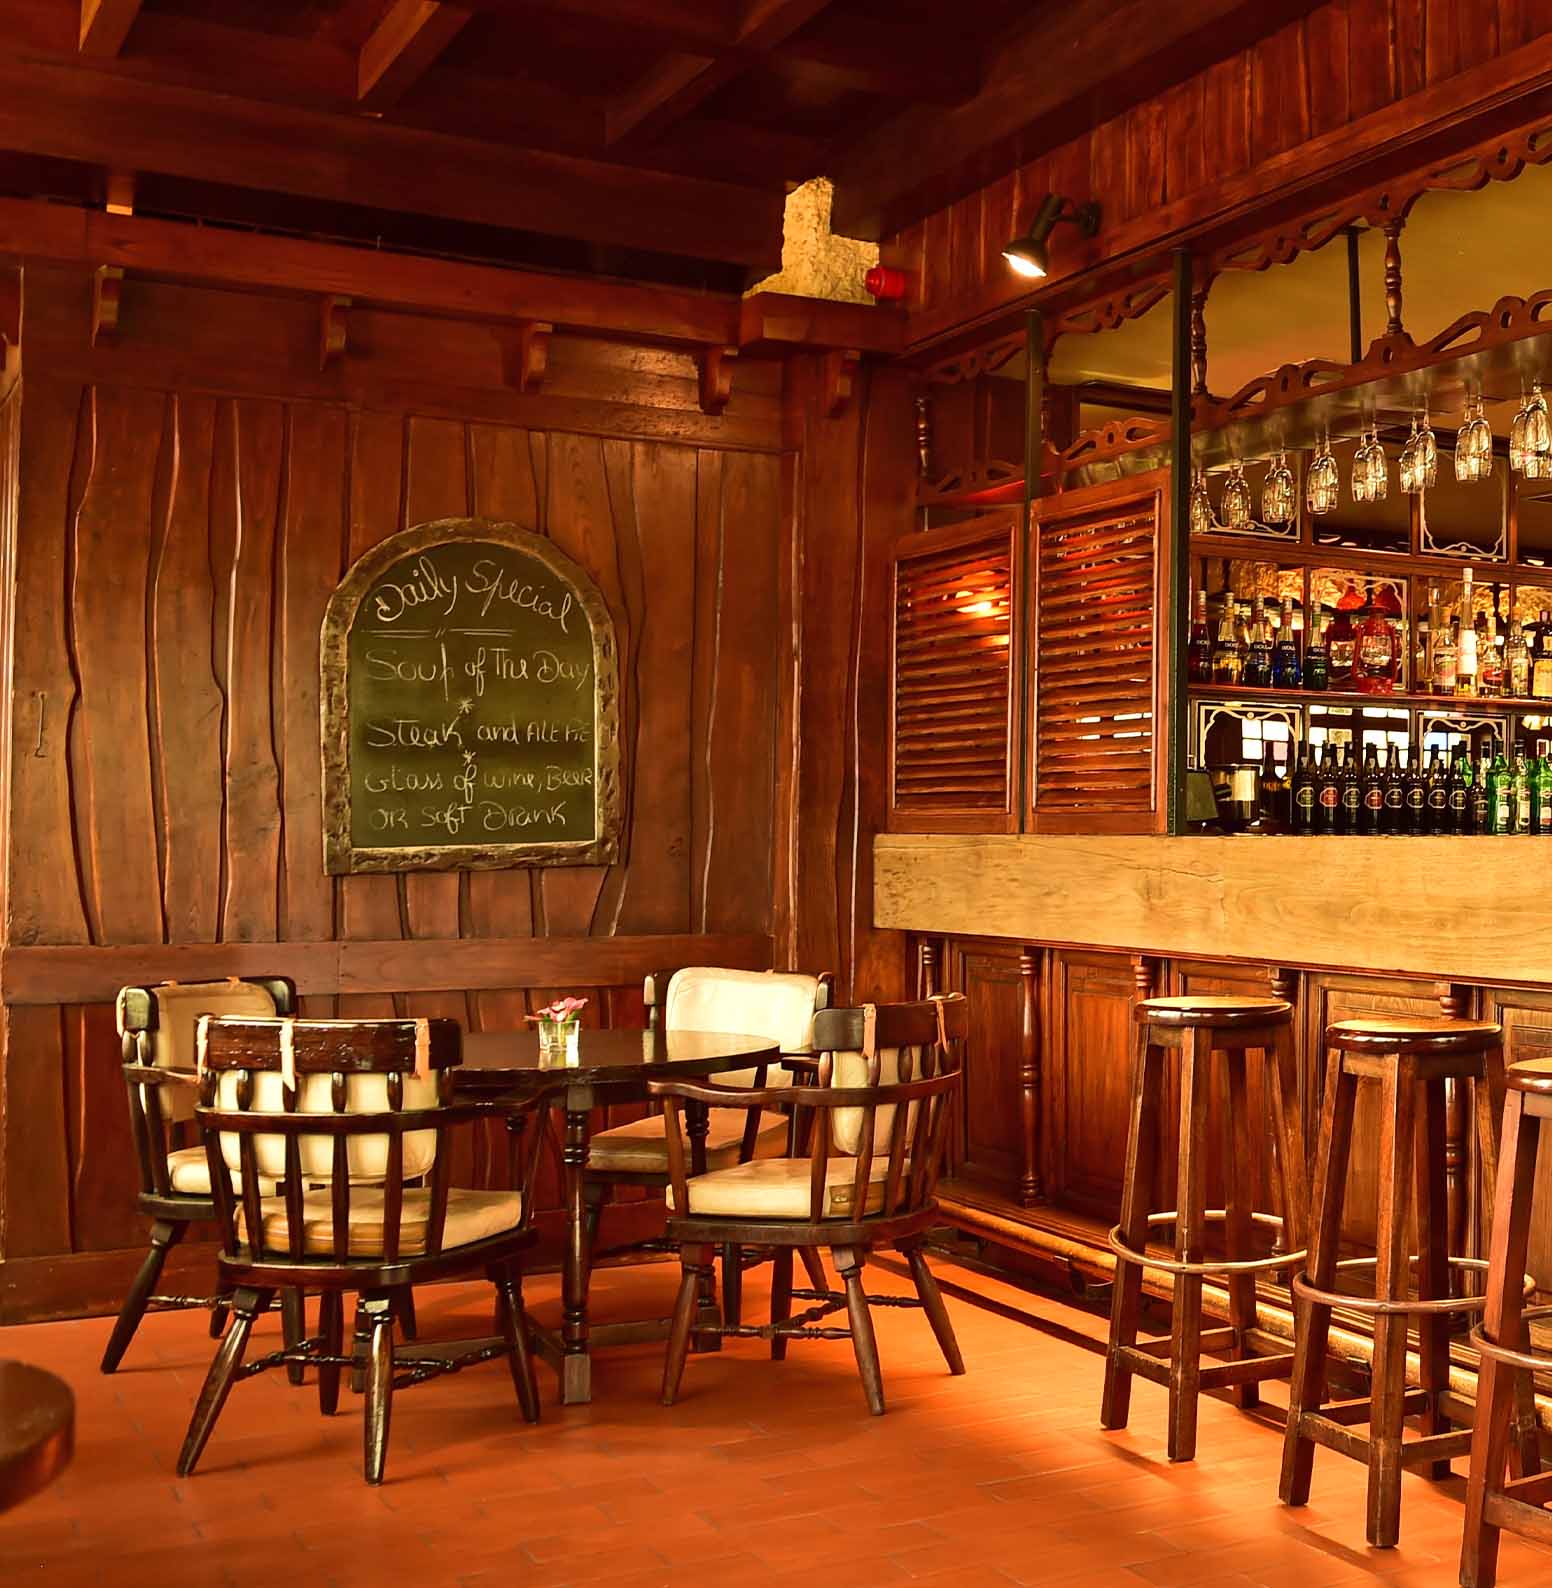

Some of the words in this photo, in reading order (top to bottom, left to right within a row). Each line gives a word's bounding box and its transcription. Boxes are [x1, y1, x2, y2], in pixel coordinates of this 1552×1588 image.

[375, 556, 458, 622] Daily
[465, 559, 573, 634] Special
[464, 646, 487, 697] of
[532, 649, 591, 692] Day
[476, 722, 520, 745] and
[364, 764, 444, 793] Glass
[452, 763, 478, 804] of
